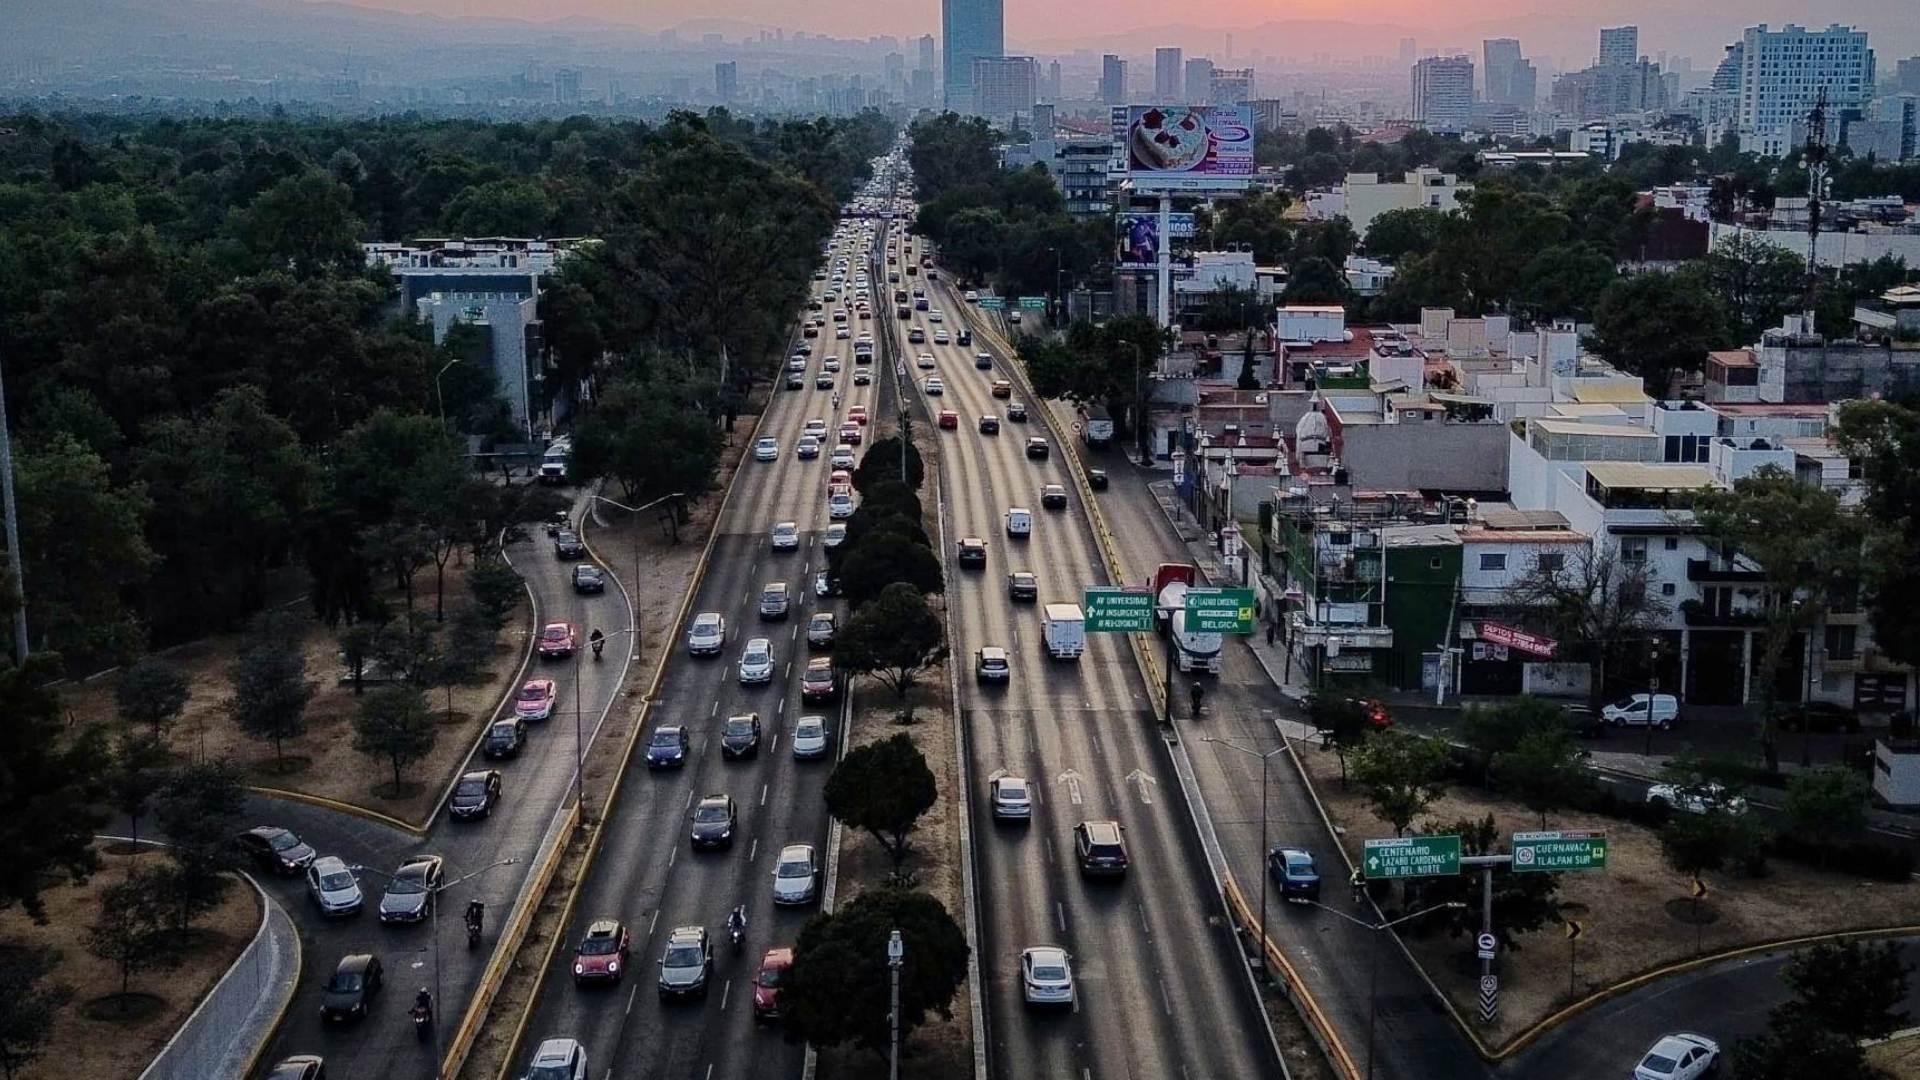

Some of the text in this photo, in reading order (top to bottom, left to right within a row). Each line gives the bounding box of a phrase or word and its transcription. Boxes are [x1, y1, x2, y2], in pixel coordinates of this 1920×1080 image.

[1106, 596, 1148, 605] UNIVERSIDAD
[1106, 609, 1151, 617] INSURGENTES
[1201, 620, 1239, 629] BELGICA
[1379, 846, 1430, 857] CENTENARIO
[1535, 843, 1591, 854] CUERNAVACA
[1410, 854, 1446, 865] CARDENAS
[1537, 855, 1591, 866] TLALPAN SUR
[1400, 866, 1413, 875] DEL
[1417, 864, 1440, 874] NORTE
